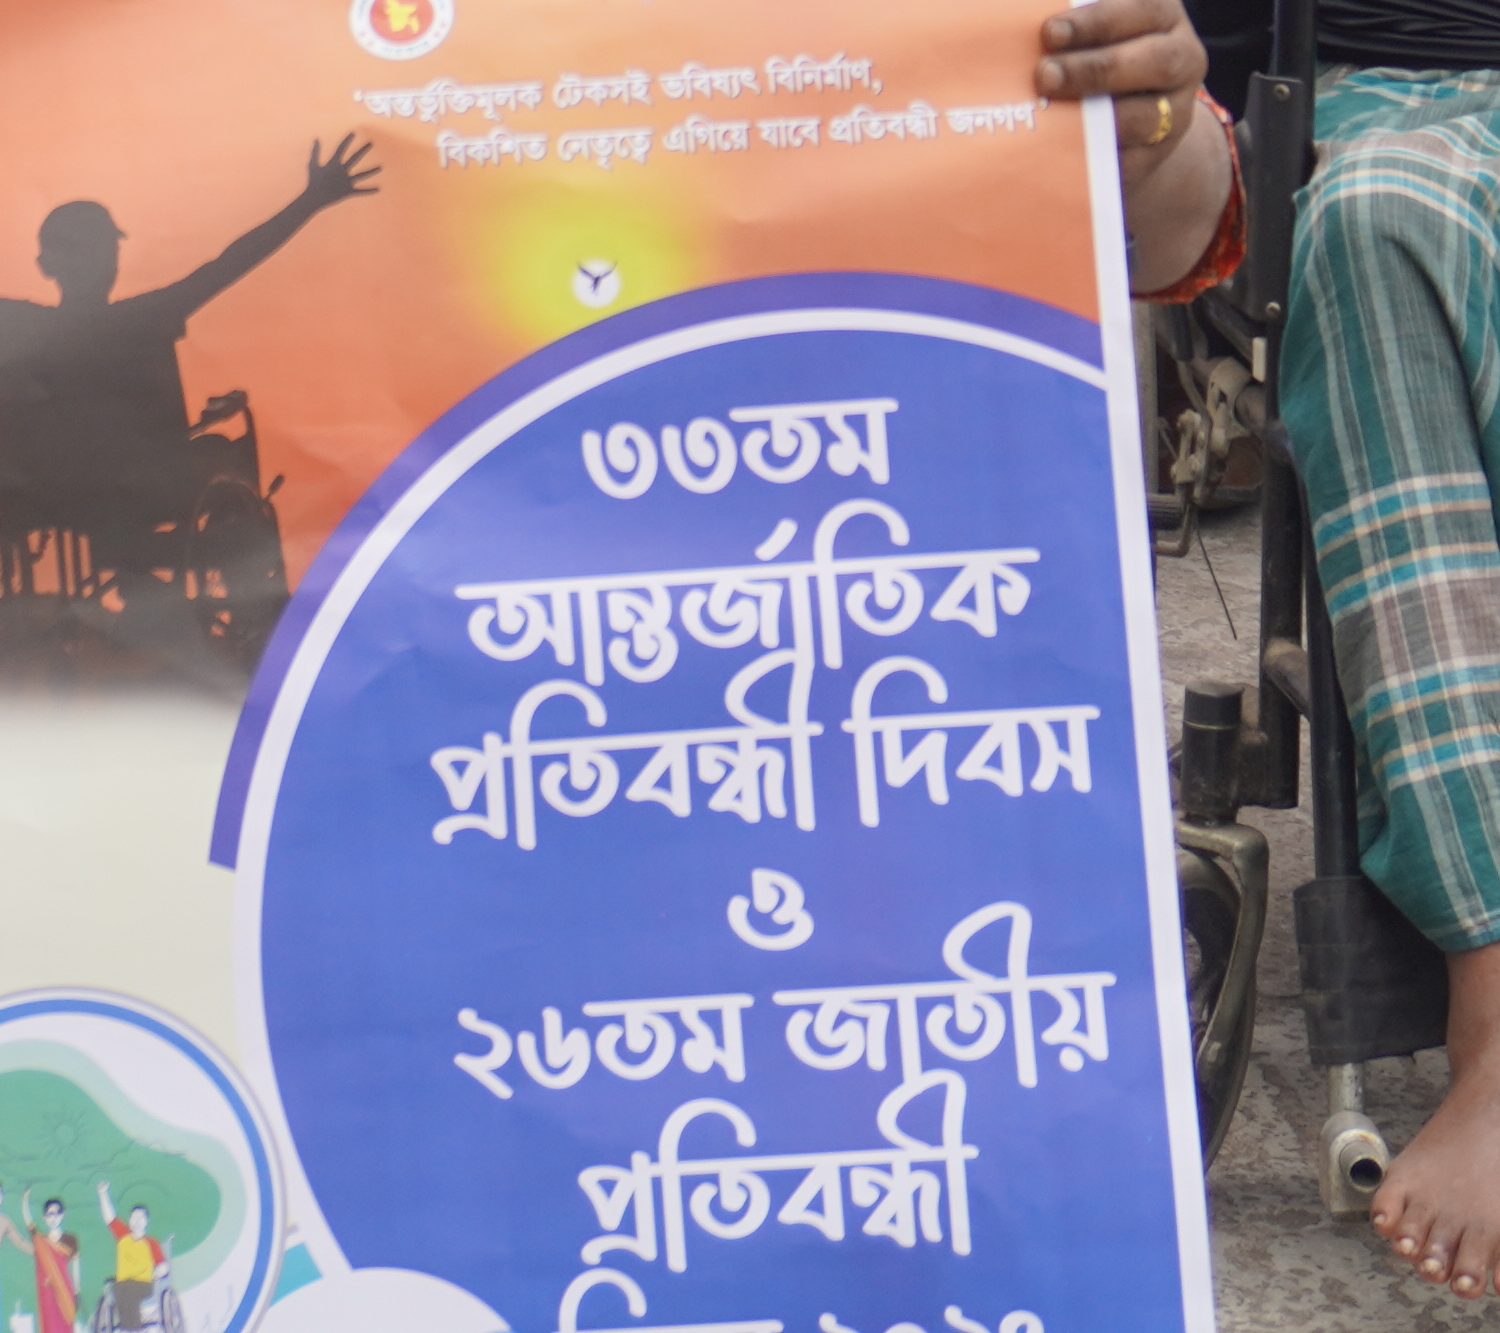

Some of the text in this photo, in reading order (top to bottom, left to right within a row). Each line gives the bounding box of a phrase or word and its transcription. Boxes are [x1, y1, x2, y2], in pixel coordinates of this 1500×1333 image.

[436, 126, 548, 169] বিকশিত
[556, 126, 653, 171] নেতৃত্বে
[662, 115, 748, 153] এগিয়ে
[758, 115, 818, 151] যাবে
[827, 98, 938, 147] প্রতিবন্ধী
[553, 68, 652, 109] টেকসই
[658, 60, 758, 101] ভবিষ্যৎ
[581, 396, 899, 500] ৩৩তম
[453, 498, 1041, 688] আন্তর্জাতিক
[430, 648, 1100, 851] প্রতিবন্ধী দিবস
[726, 867, 815, 951] ও
[452, 900, 1116, 1100] ২৬তম জাতীয়
[577, 1068, 979, 1273] প্রতিবন্ধী
